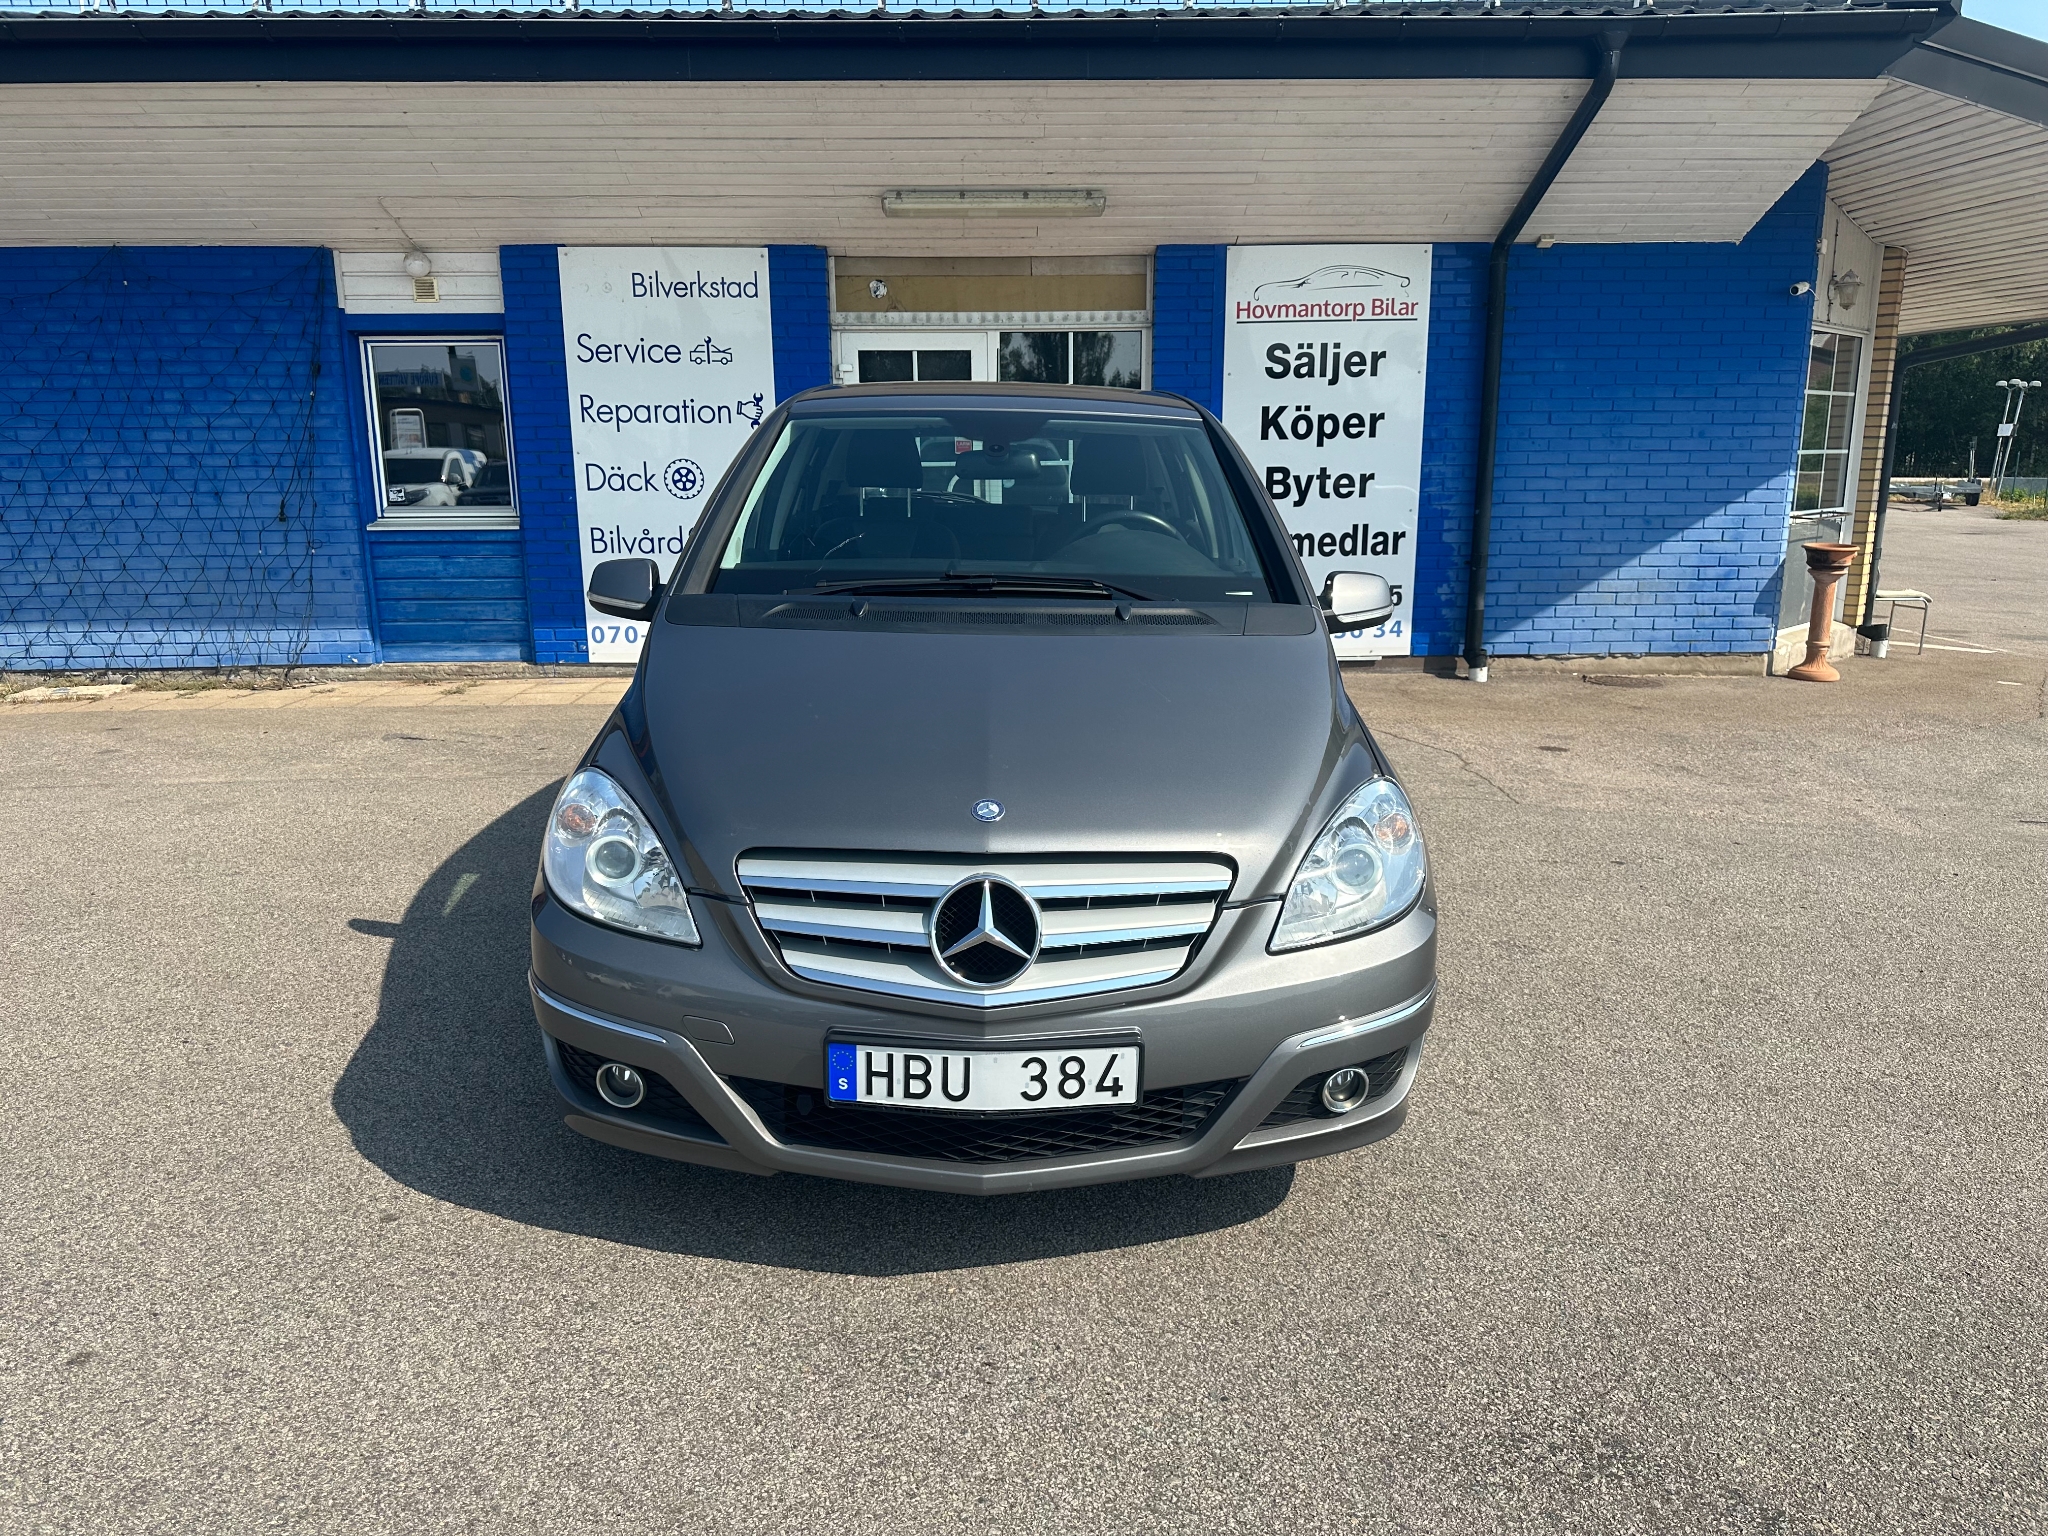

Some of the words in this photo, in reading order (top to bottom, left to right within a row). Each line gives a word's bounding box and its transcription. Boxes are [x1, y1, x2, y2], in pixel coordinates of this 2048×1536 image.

[631, 270, 759, 299] Bilverkstad
[1236, 300, 1366, 322] Hovmantorp
[1371, 297, 1419, 317] Bilar
[576, 333, 682, 364] Service
[1264, 342, 1387, 386] Säljer
[580, 394, 732, 432] Reparation
[1260, 405, 1385, 447] Köper
[585, 461, 659, 492] Däck
[1265, 466, 1375, 507] Byter
[838, 1077, 849, 1090] S
[865, 1051, 971, 1102] HBU
[1020, 1053, 1123, 1101] 384
